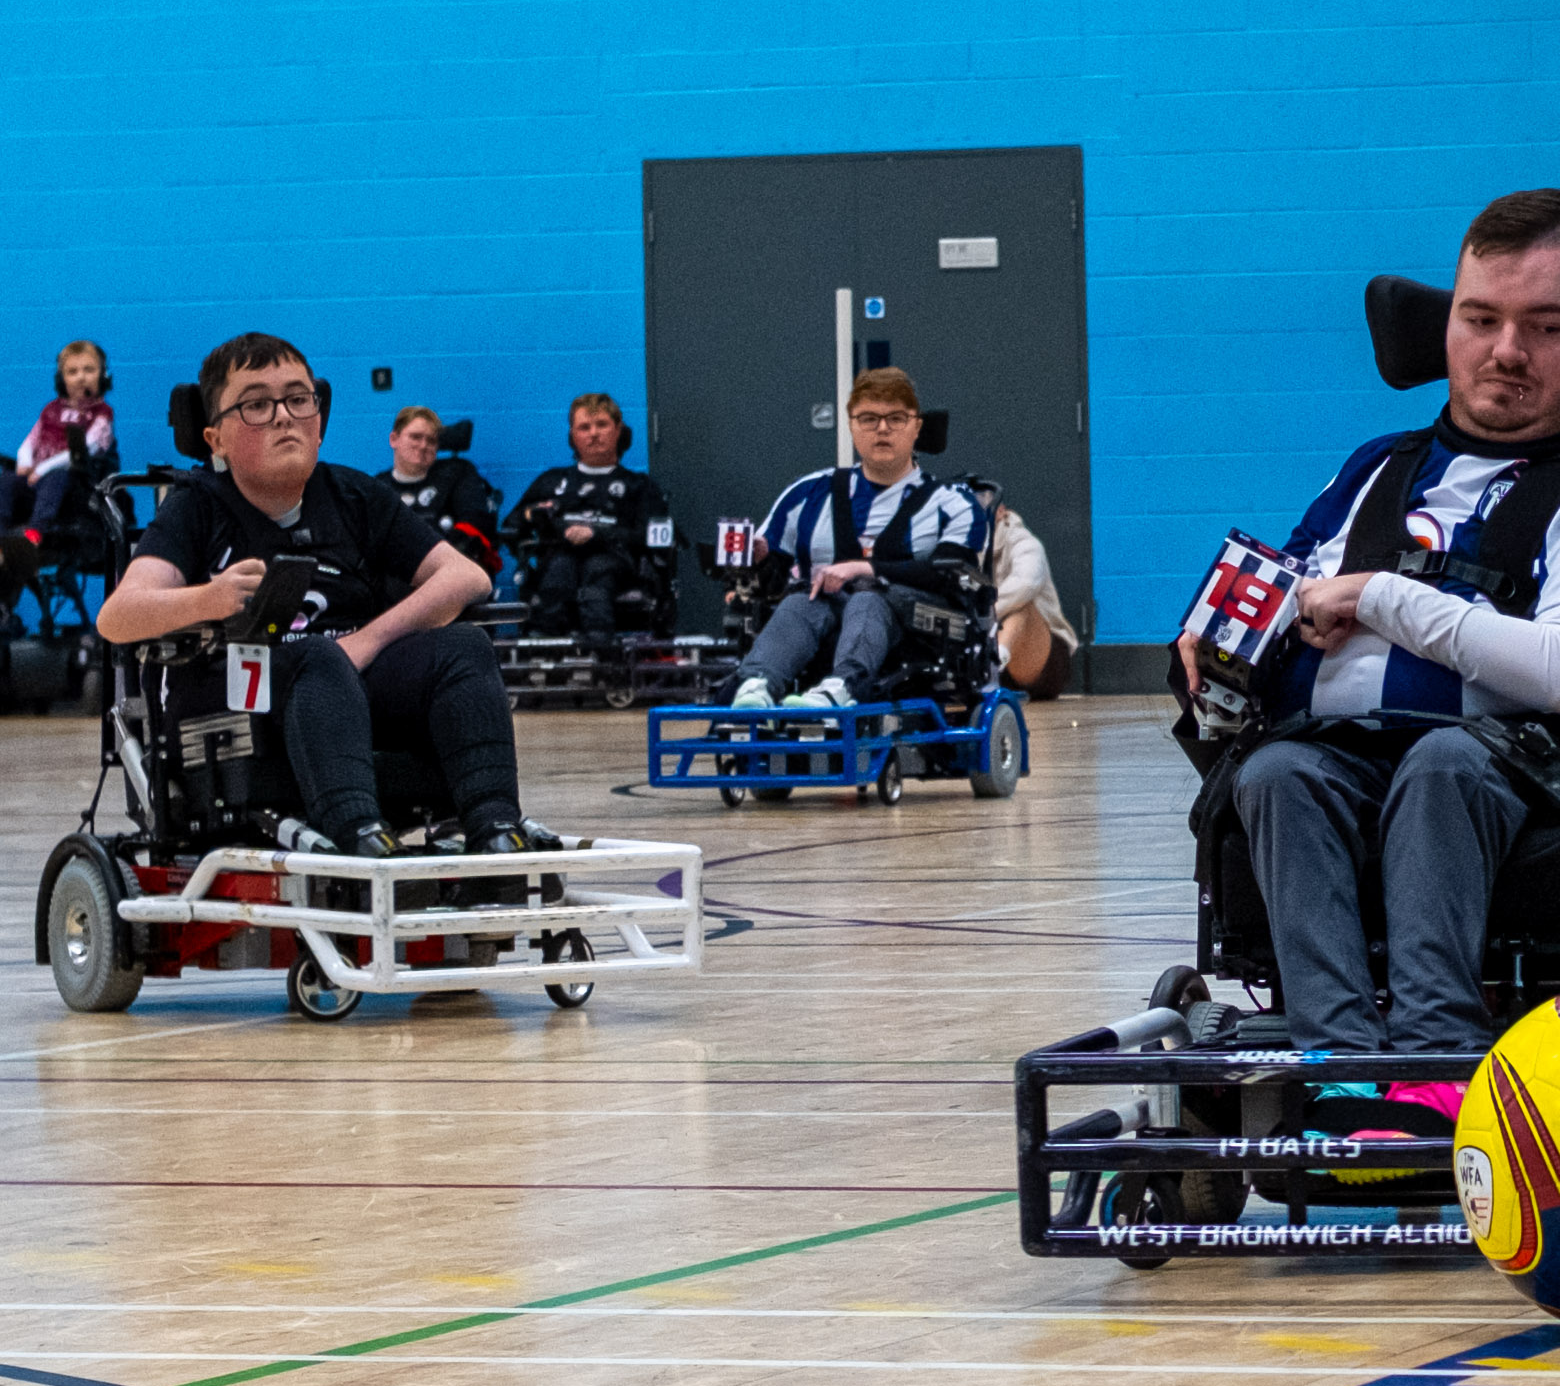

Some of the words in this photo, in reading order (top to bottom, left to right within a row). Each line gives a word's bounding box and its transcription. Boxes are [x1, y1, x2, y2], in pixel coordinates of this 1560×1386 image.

[650, 526, 670, 545] 10
[1206, 561, 1285, 631] 19
[241, 660, 262, 710] 7
[1219, 1137, 1250, 1158] 19
[1258, 1136, 1362, 1158] BATES
[1464, 1153, 1475, 1165] The
[1460, 1166, 1483, 1187] WFA
[1098, 1224, 1184, 1247] WEST
[1198, 1224, 1372, 1246] BROMWICH
[1383, 1223, 1475, 1246] ALBIO
